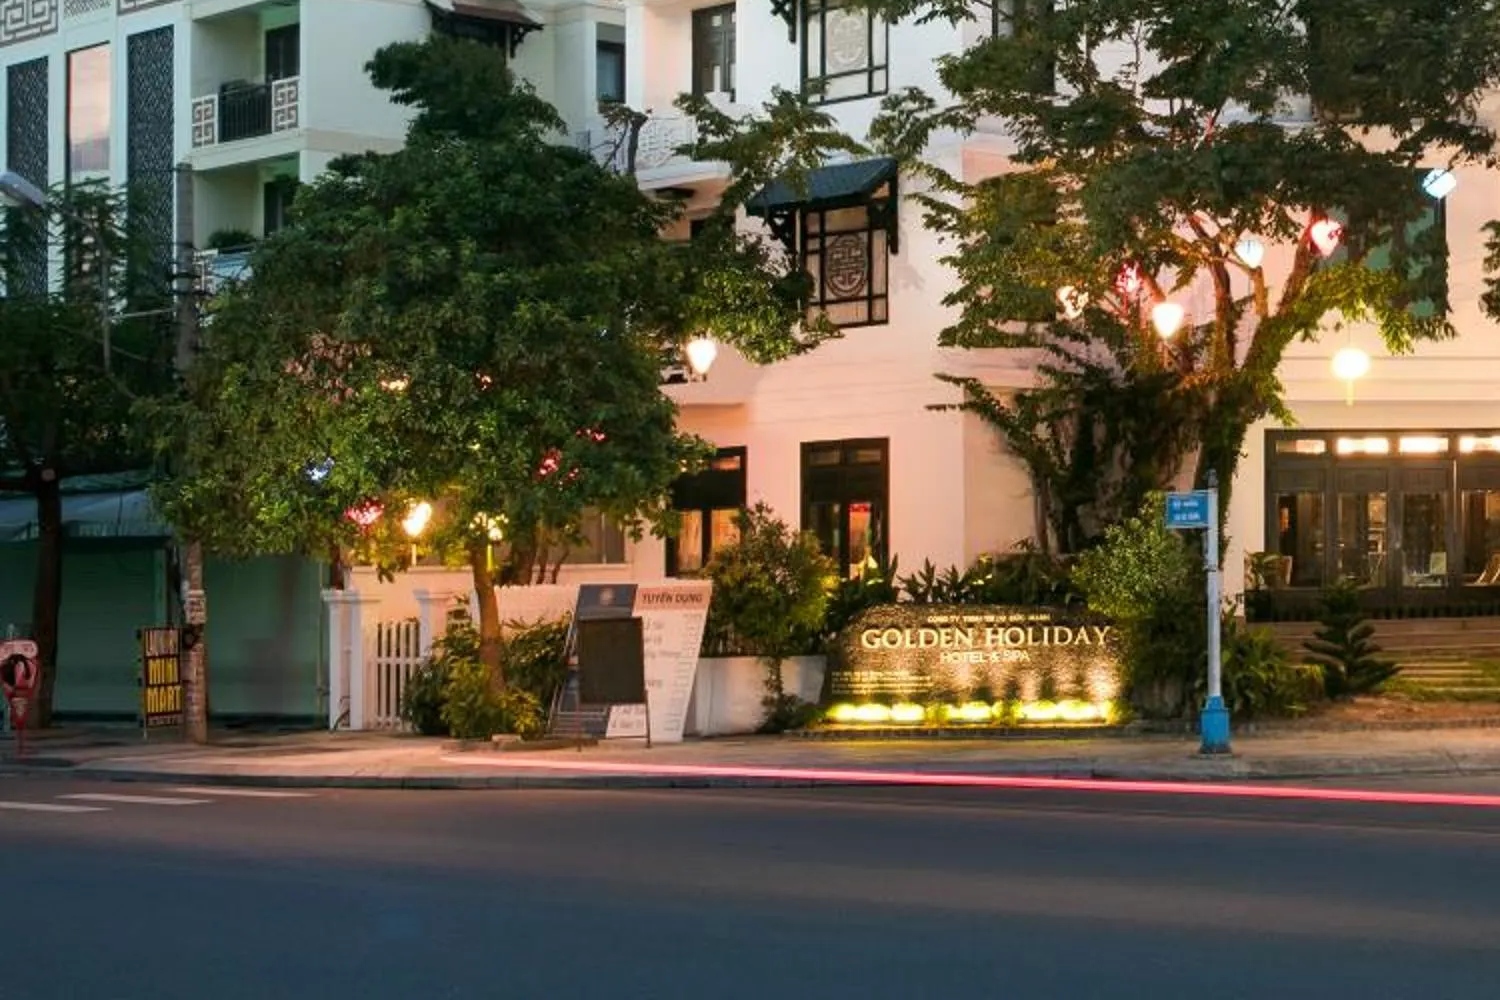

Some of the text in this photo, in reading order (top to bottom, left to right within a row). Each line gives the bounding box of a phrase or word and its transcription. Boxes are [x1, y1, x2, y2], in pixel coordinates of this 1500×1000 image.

[861, 626, 1111, 649] GOLDEN HOLIDAY
[941, 649, 1031, 664] HOTEL & SPA
[148, 658, 178, 685] MINI
[147, 686, 181, 713] MART
